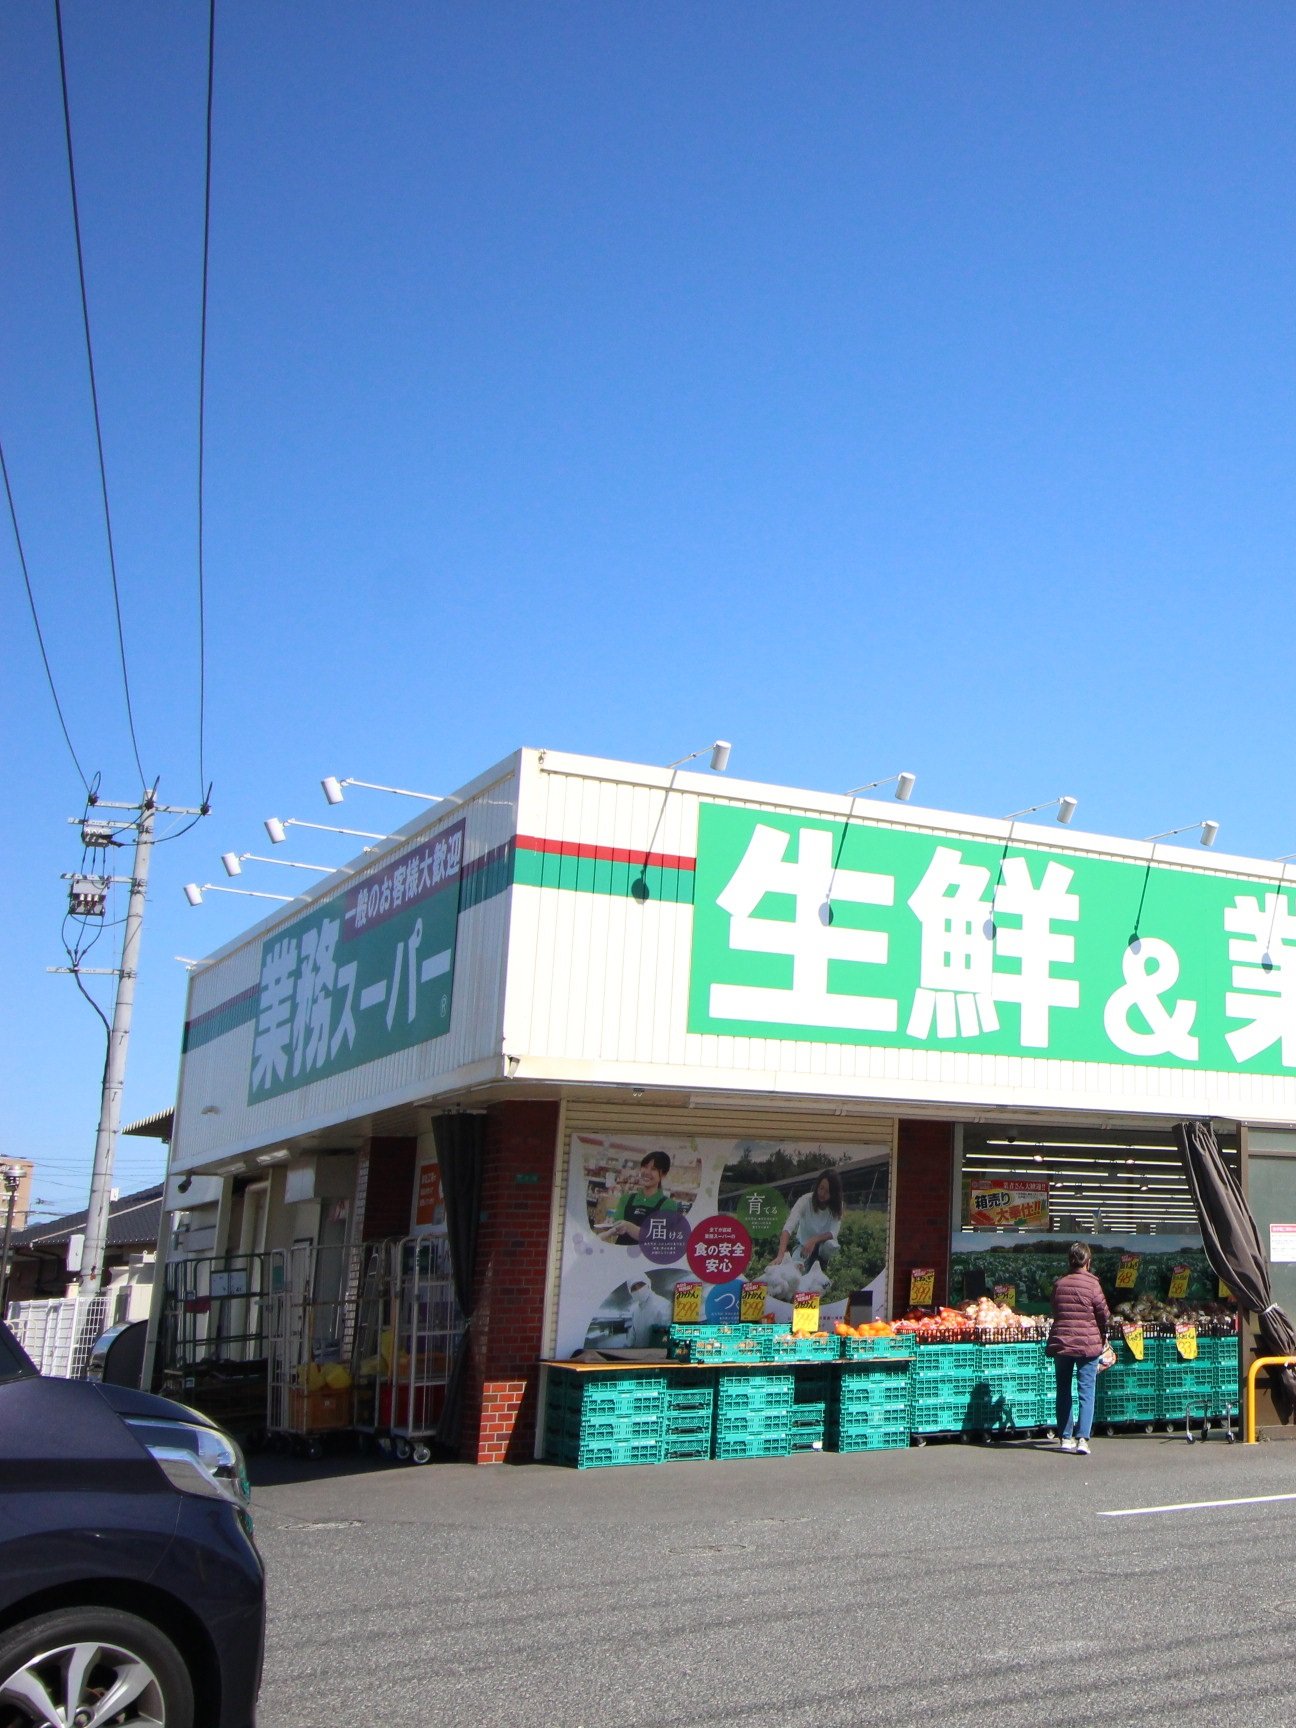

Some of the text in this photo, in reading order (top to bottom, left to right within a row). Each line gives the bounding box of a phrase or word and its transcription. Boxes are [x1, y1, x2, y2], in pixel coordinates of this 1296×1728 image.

[345, 830, 462, 929] 一般のお客様大歓迎
[252, 916, 452, 1090] 業務スーパー
[746, 1193, 778, 1215] 育てる
[975, 1192, 1011, 1210] 箱売り
[645, 1218, 684, 1240] 届ける
[694, 1242, 745, 1257] 食の安全
[705, 1258, 733, 1273] 安心
